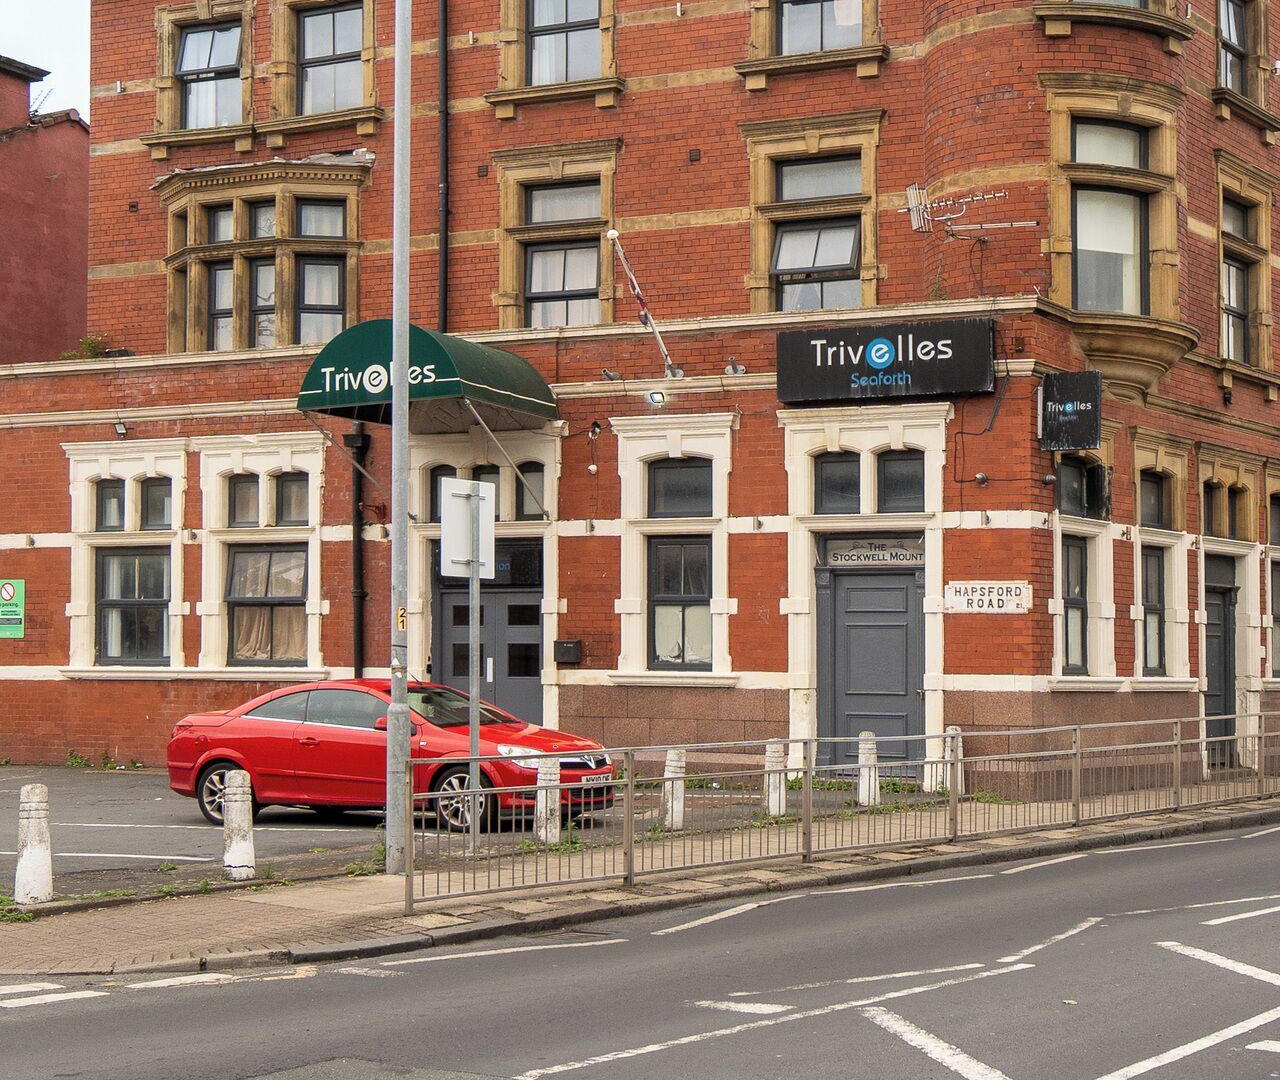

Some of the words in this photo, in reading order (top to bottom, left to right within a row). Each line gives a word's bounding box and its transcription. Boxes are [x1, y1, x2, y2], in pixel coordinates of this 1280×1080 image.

[810, 334, 953, 369] Trivelles
[851, 371, 912, 388] Seaforth
[1046, 400, 1092, 413] Trivelles
[867, 542, 887, 552] THE
[832, 552, 888, 562] STOCKWELL
[889, 552, 924, 562] MOUNT
[954, 586, 1023, 597] HAPSFORD
[966, 598, 1005, 609] ROAD
